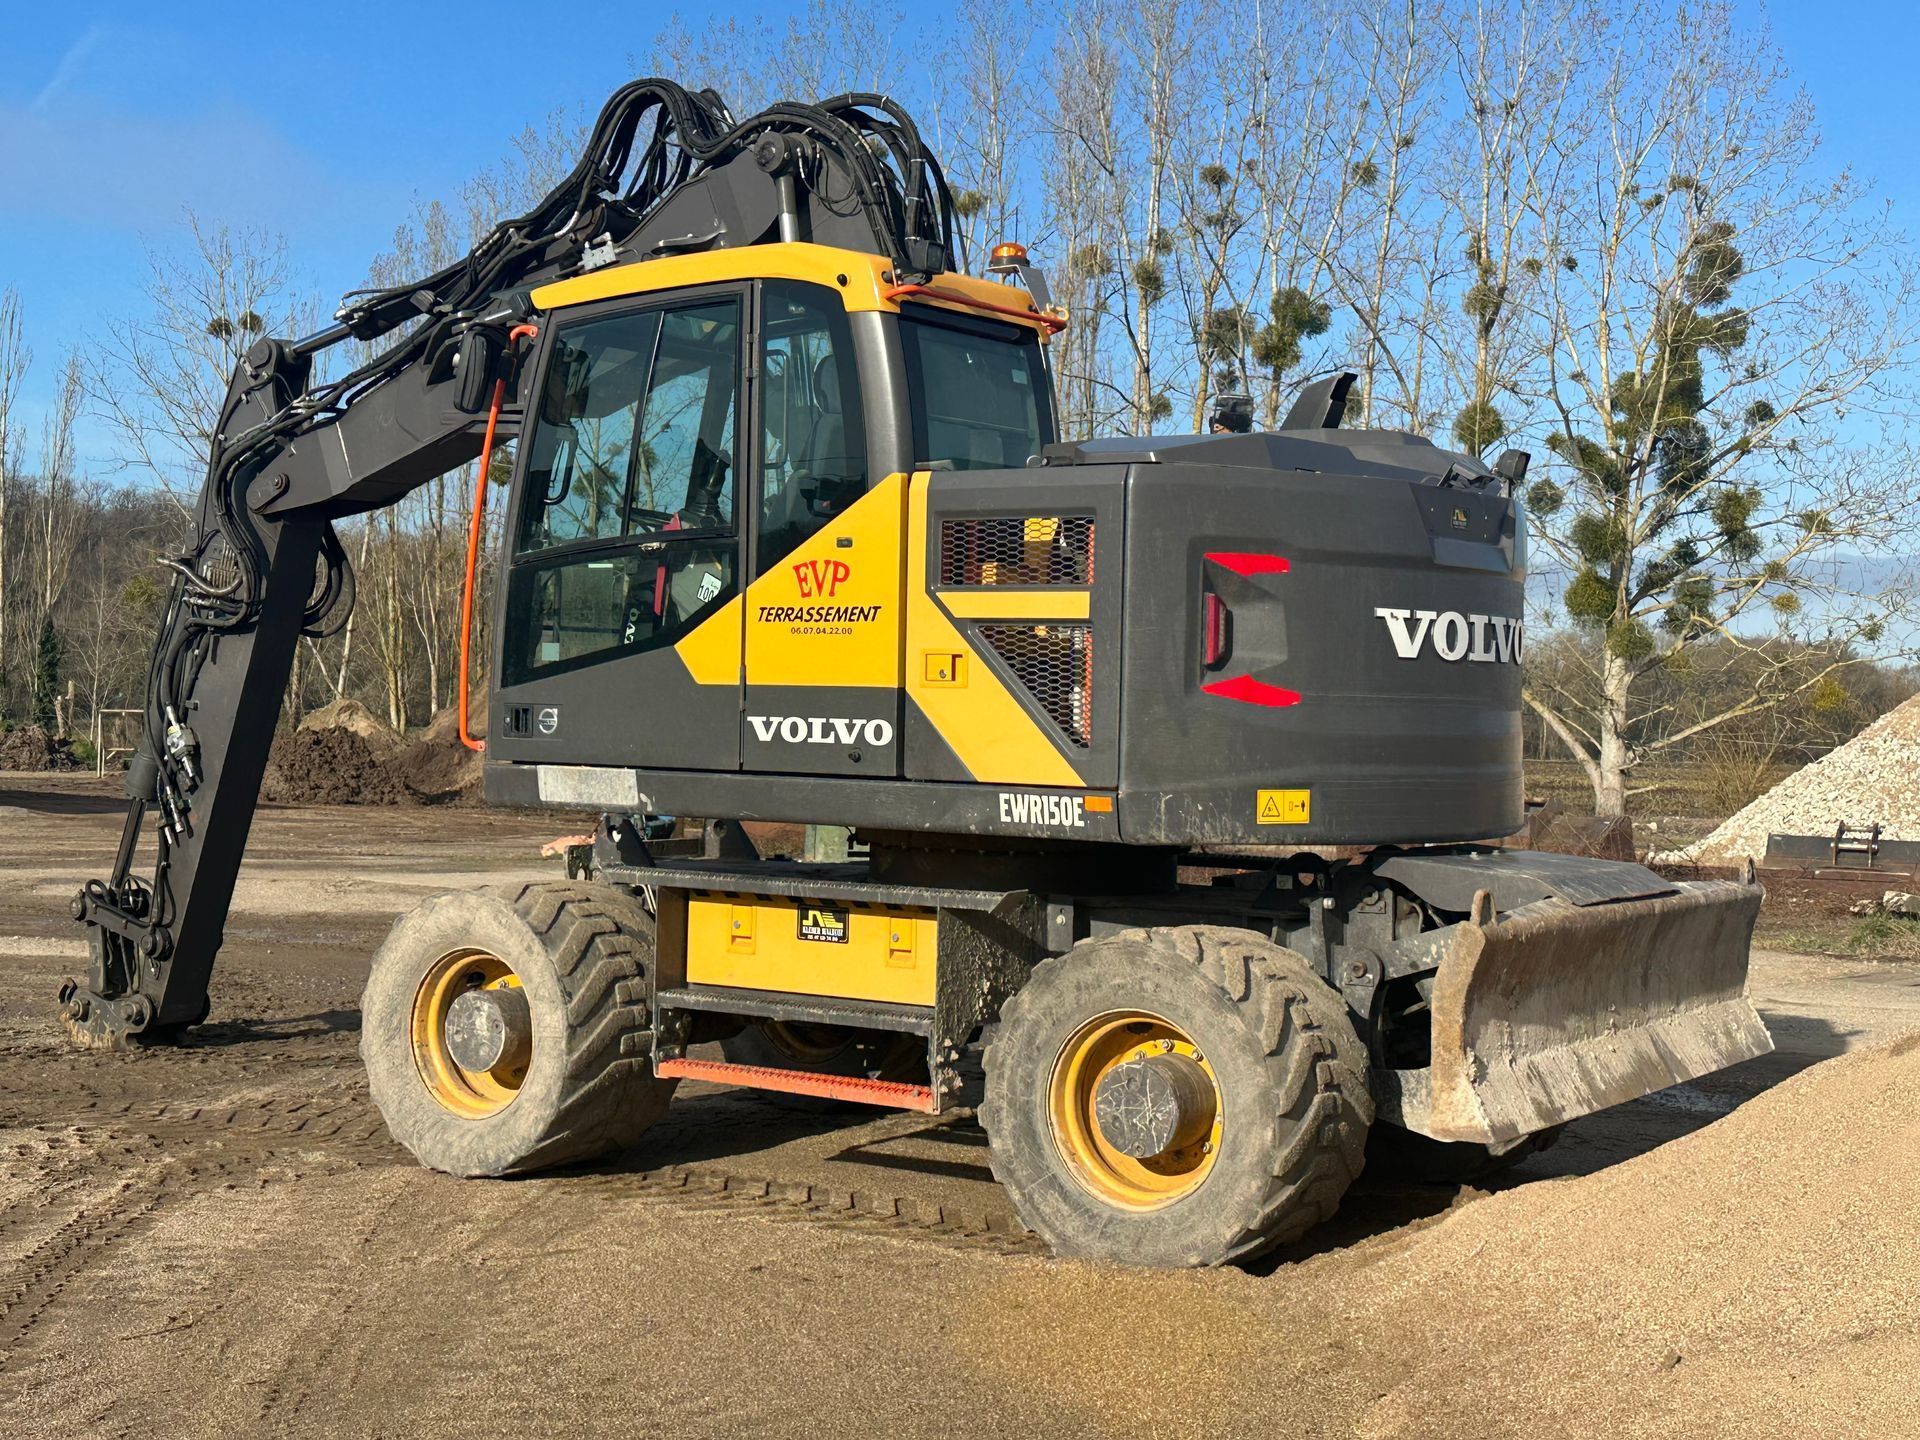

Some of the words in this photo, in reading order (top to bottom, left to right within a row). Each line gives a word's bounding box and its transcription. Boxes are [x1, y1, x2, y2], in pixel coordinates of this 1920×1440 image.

[792, 559, 851, 599] EVP
[758, 606, 882, 623] TERRASSEMENT
[790, 627, 853, 635] 06.07.04.22.00
[1374, 607, 1524, 665] VOLVO
[747, 716, 893, 746] VOLVO
[999, 793, 1085, 827] EWR150E
